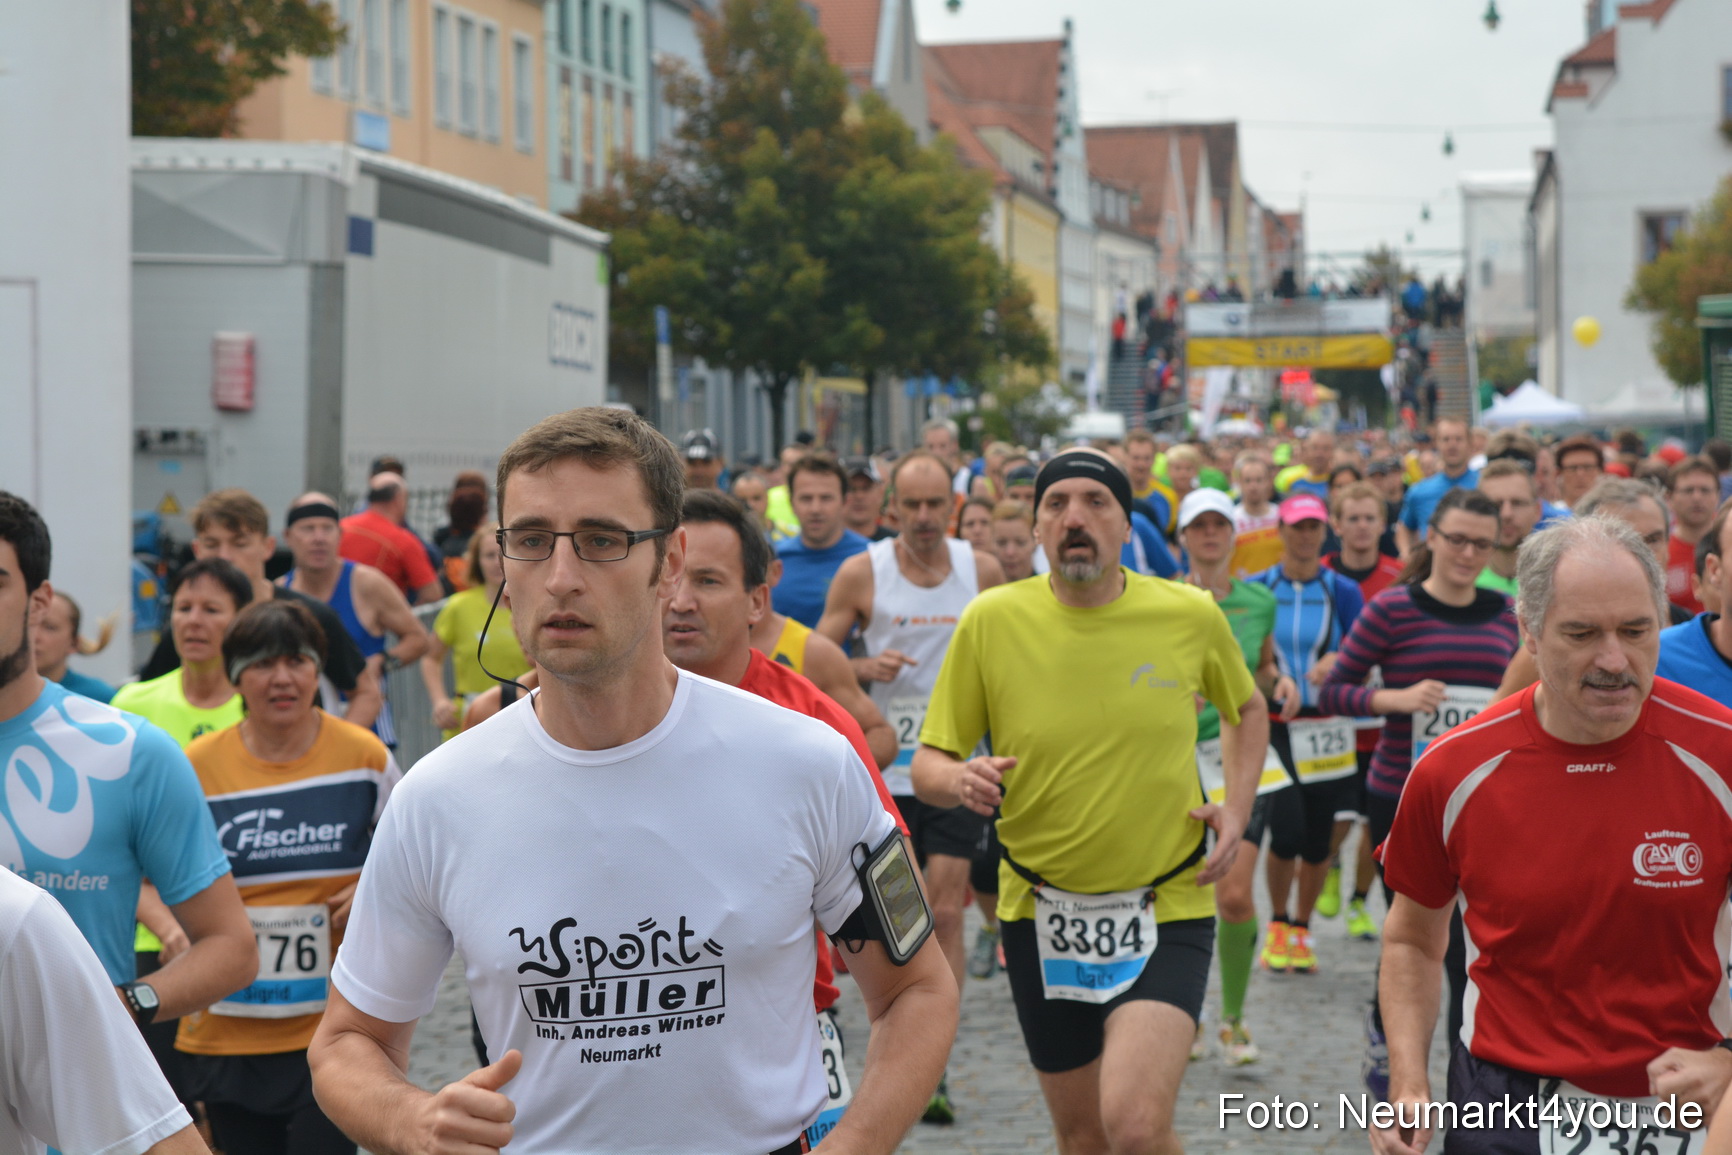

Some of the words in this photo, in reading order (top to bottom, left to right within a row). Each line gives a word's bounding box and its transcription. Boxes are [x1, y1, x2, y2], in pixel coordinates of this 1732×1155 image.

[1257, 342, 1323, 360] START
[1566, 764, 1606, 773] CRAFT
[237, 821, 348, 851] Fischer
[1645, 829, 1690, 840] Laufteam
[247, 841, 342, 861] AUTOMOBILE
[1651, 843, 1677, 864] ASV
[33, 869, 109, 891] andere
[1633, 877, 1671, 889] Kraftsport
[1680, 878, 1704, 887] Fitness
[1047, 913, 1144, 957] 3384
[534, 978, 716, 1019] Müller
[536, 1024, 565, 1041] Inh.
[571, 1023, 651, 1040] Andreas
[658, 1012, 725, 1033] Winter
[580, 1043, 662, 1064] Neumarkt
